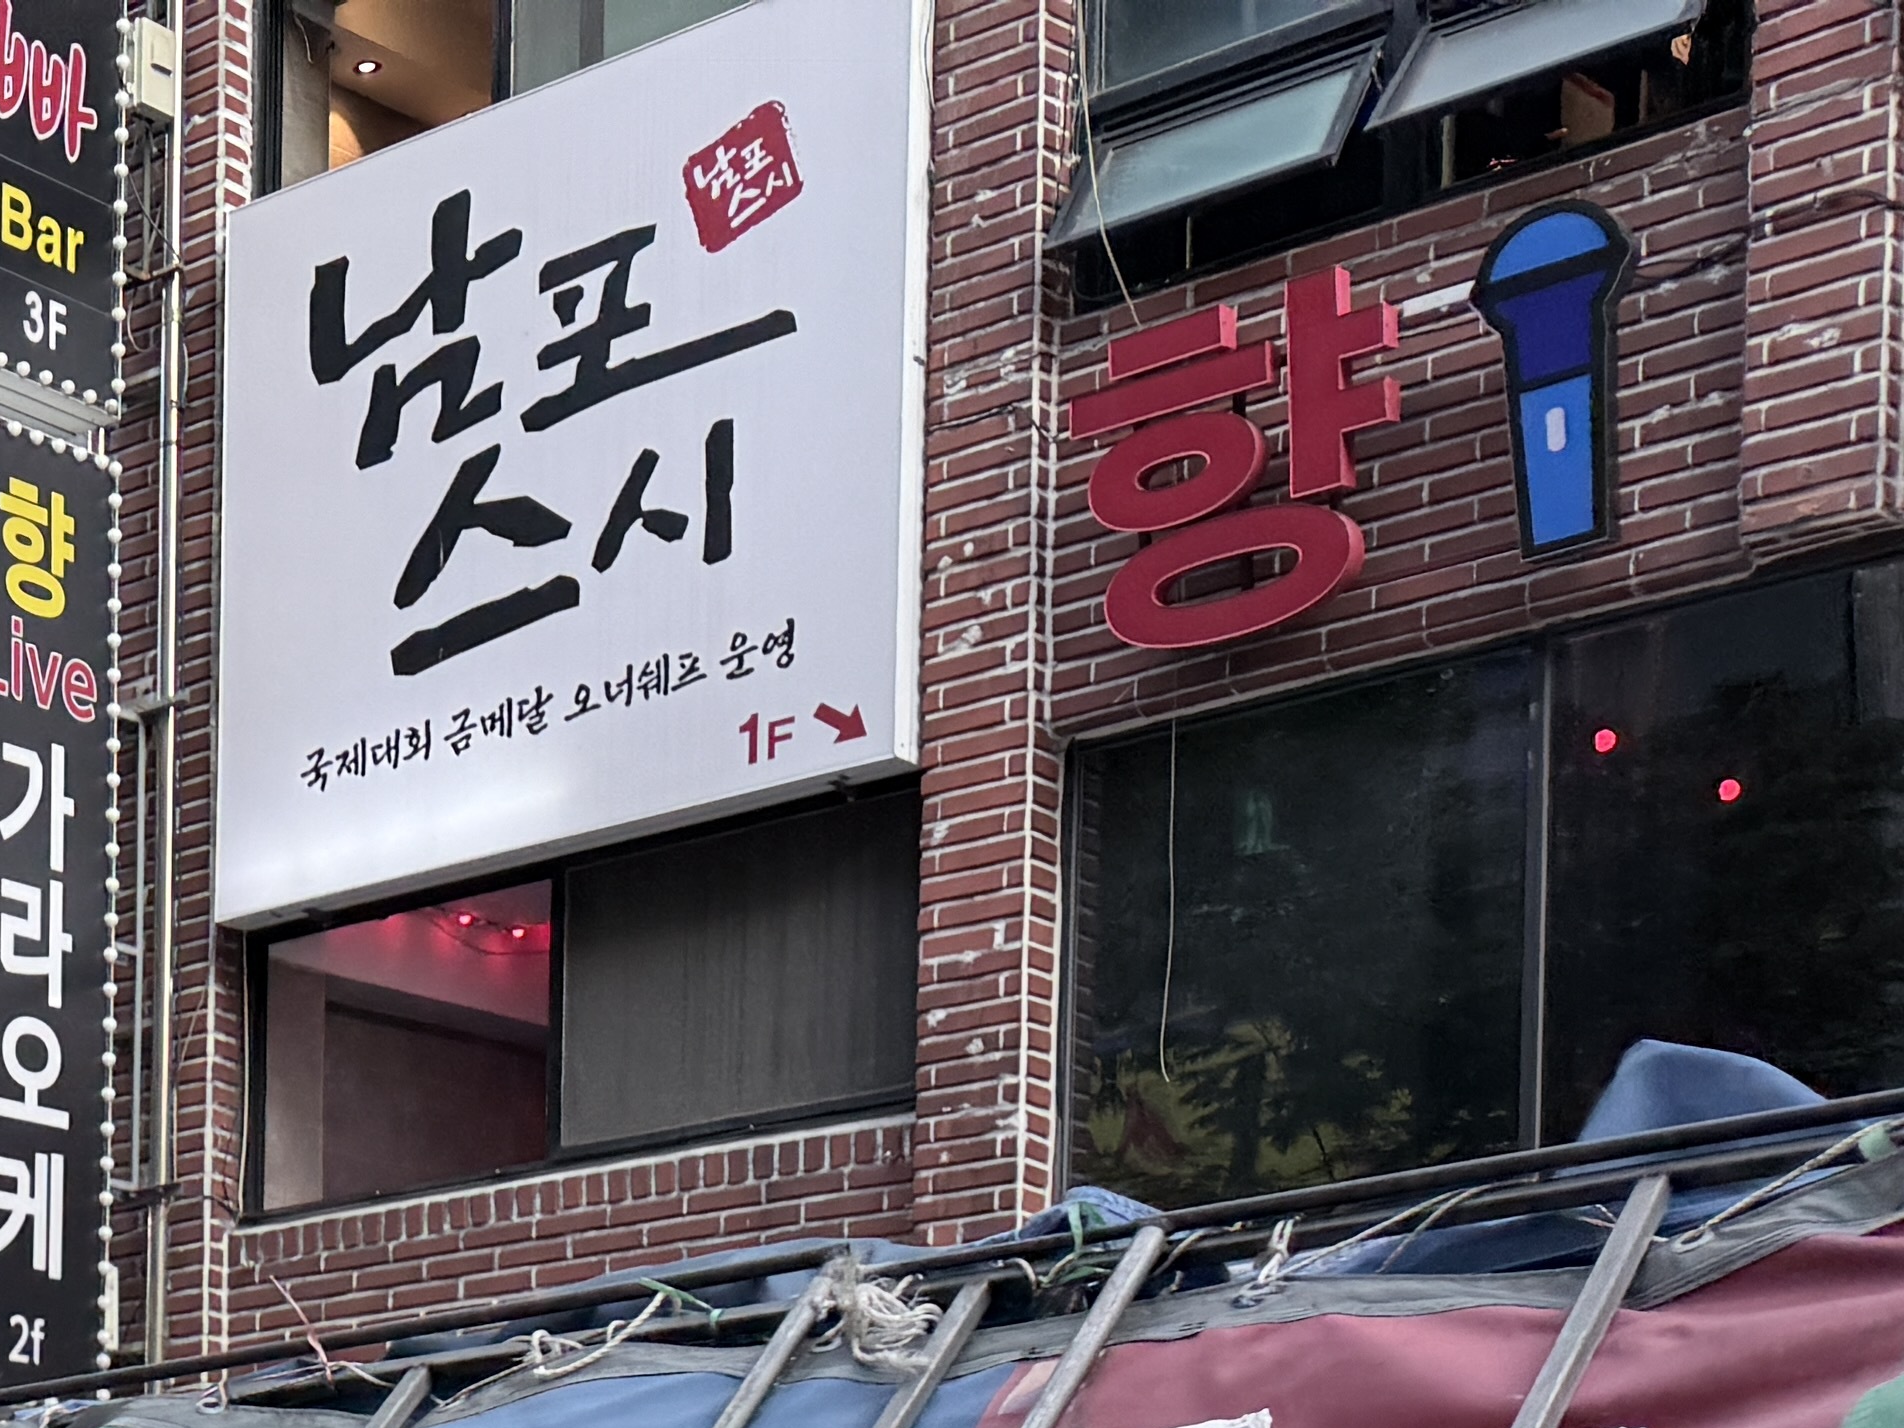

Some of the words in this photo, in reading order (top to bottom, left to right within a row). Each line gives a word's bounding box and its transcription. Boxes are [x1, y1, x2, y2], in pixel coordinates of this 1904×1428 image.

[1, 181, 84, 275] Bar
[23, 290, 67, 350] 3F
[308, 190, 797, 470] 남포
[1068, 265, 1401, 649] 향
[390, 418, 735, 677] 스시
[299, 726, 433, 792] 국제대회
[444, 685, 553, 757] 금메달
[718, 617, 797, 684] 운영
[738, 713, 793, 765] 1F
